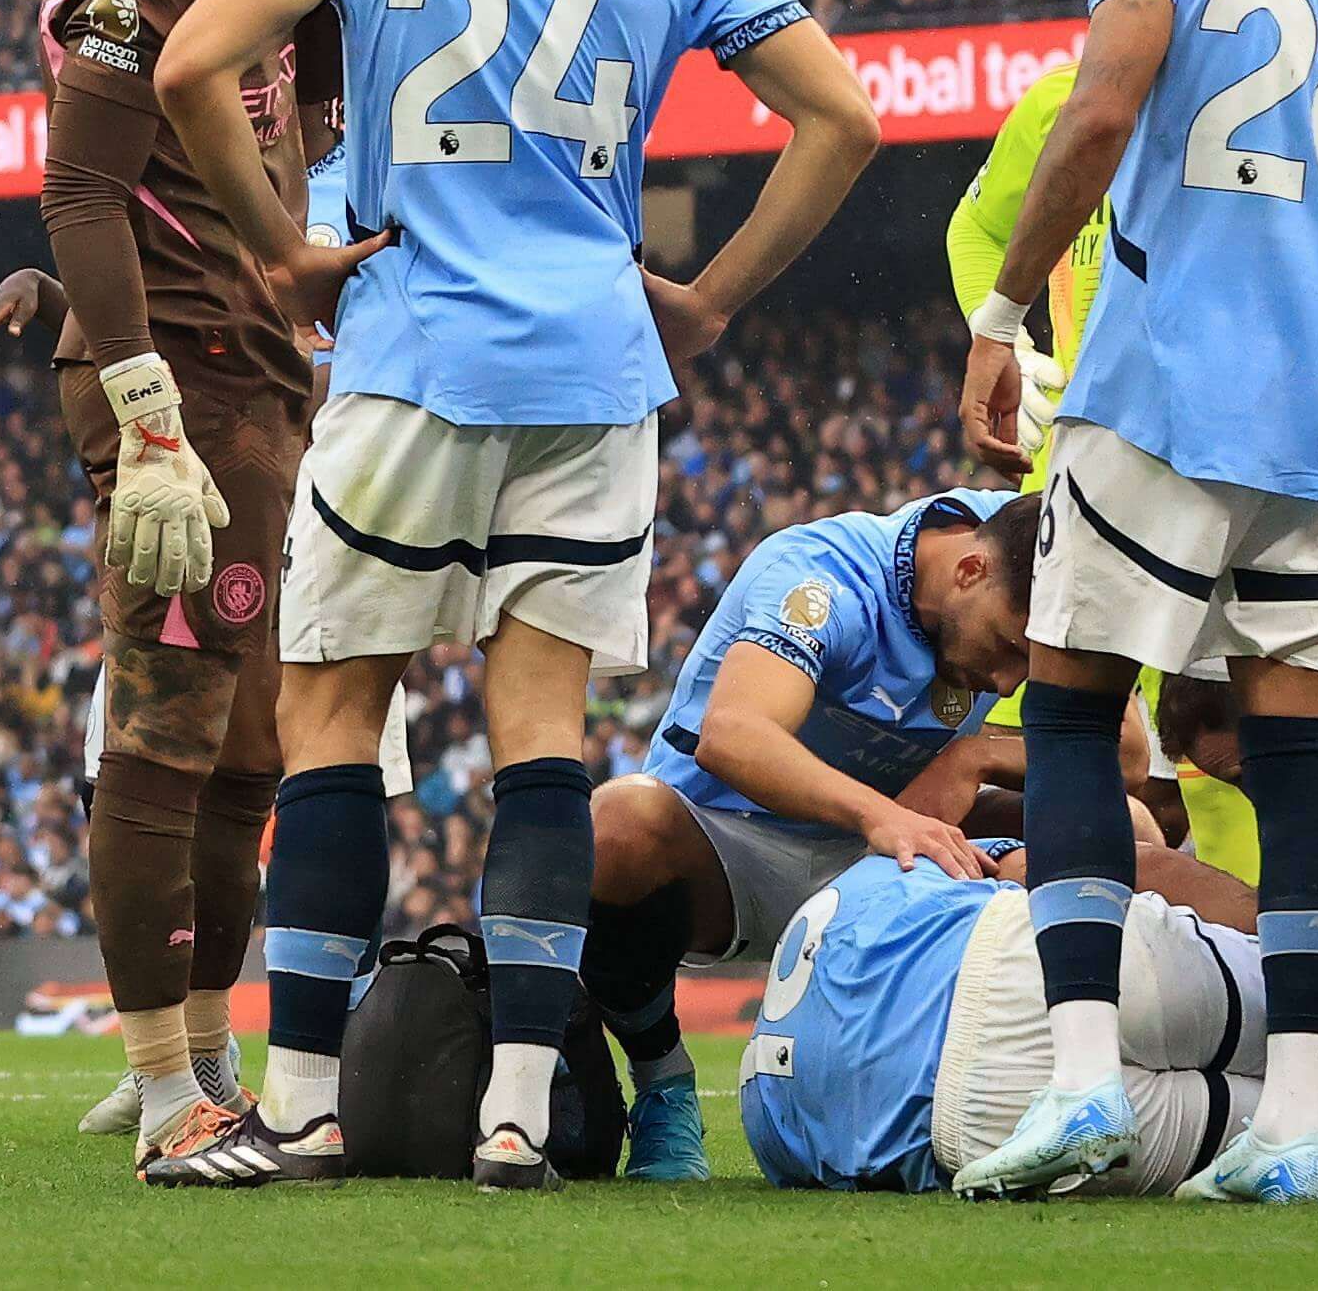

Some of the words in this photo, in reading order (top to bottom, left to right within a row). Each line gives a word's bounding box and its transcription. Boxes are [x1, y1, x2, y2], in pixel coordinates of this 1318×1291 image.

[78, 45, 99, 59] for
[96, 50, 140, 74] racism
[82, 34, 102, 48] No
[101, 40, 138, 61] room
[1071, 234, 1099, 267] FLY
